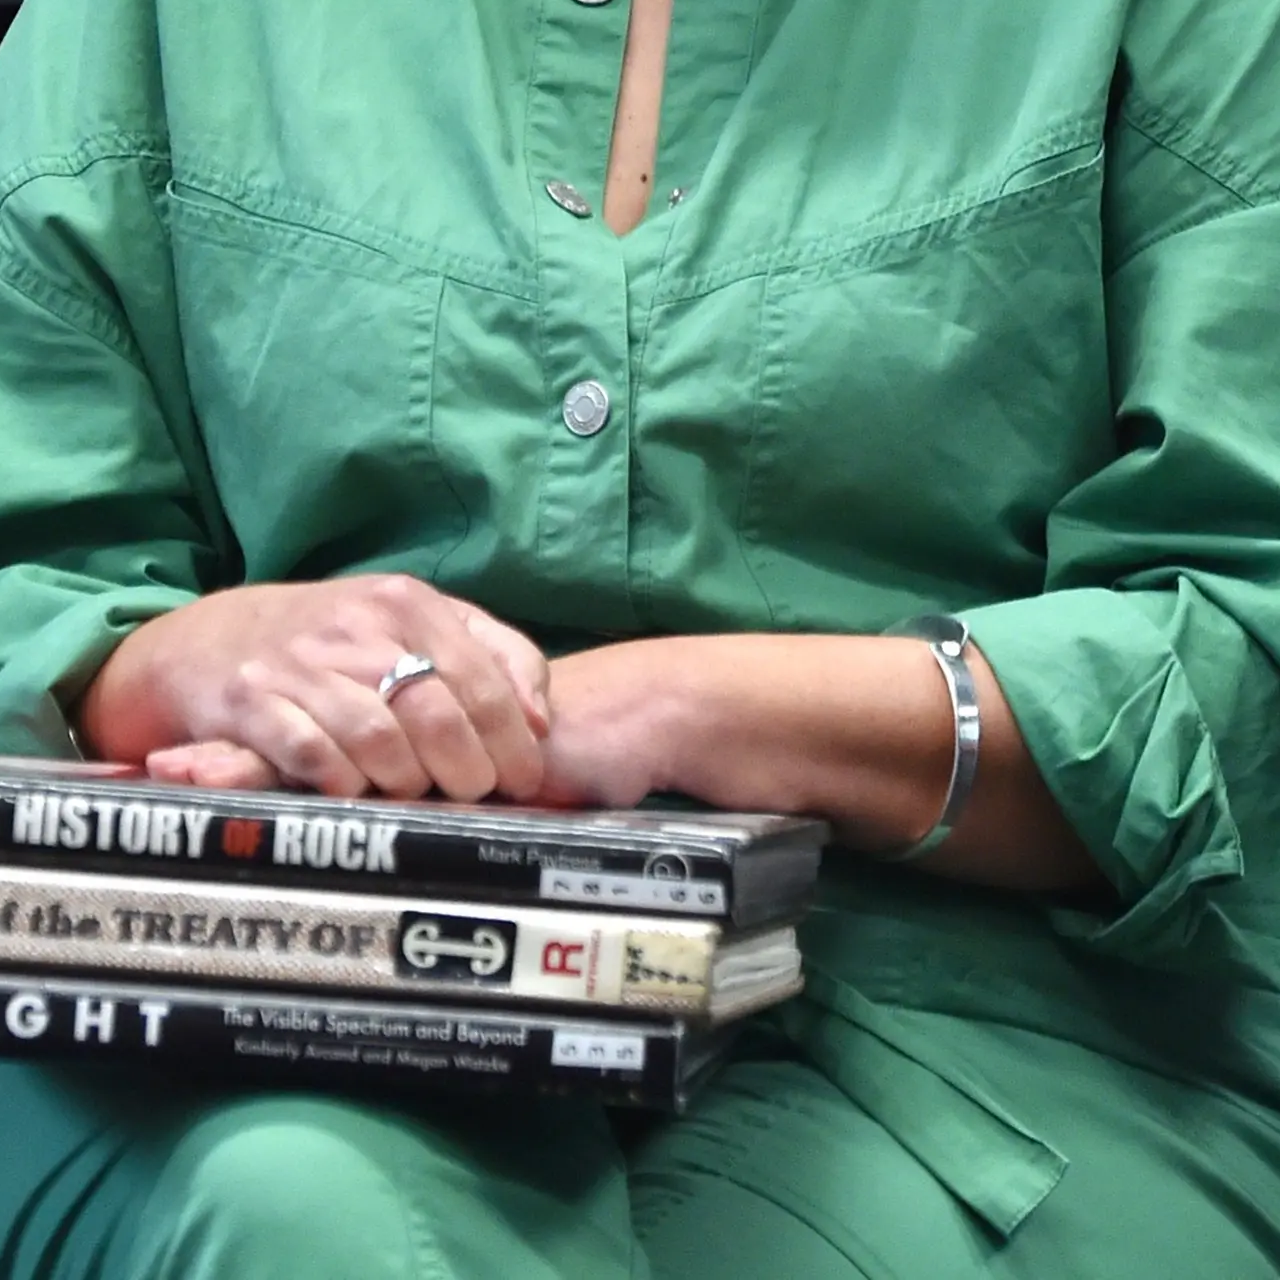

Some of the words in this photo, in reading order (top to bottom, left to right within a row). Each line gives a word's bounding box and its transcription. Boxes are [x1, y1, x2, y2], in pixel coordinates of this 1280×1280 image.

[11, 793, 214, 859] HISTORY
[222, 816, 264, 858] OF
[271, 813, 402, 874] ROCK
[477, 843, 521, 866] Mark
[28, 902, 102, 940] the
[111, 908, 303, 952] TREATY
[308, 921, 377, 959] OF
[539, 938, 586, 979] R
[222, 1007, 254, 1028] The
[259, 1008, 320, 1032] Visible
[324, 1013, 410, 1040] Spectrum
[415, 1021, 453, 1042] and
[456, 1023, 527, 1049] Beyond
[233, 1037, 300, 1063] Kimberly
[361, 1048, 393, 1066] and
